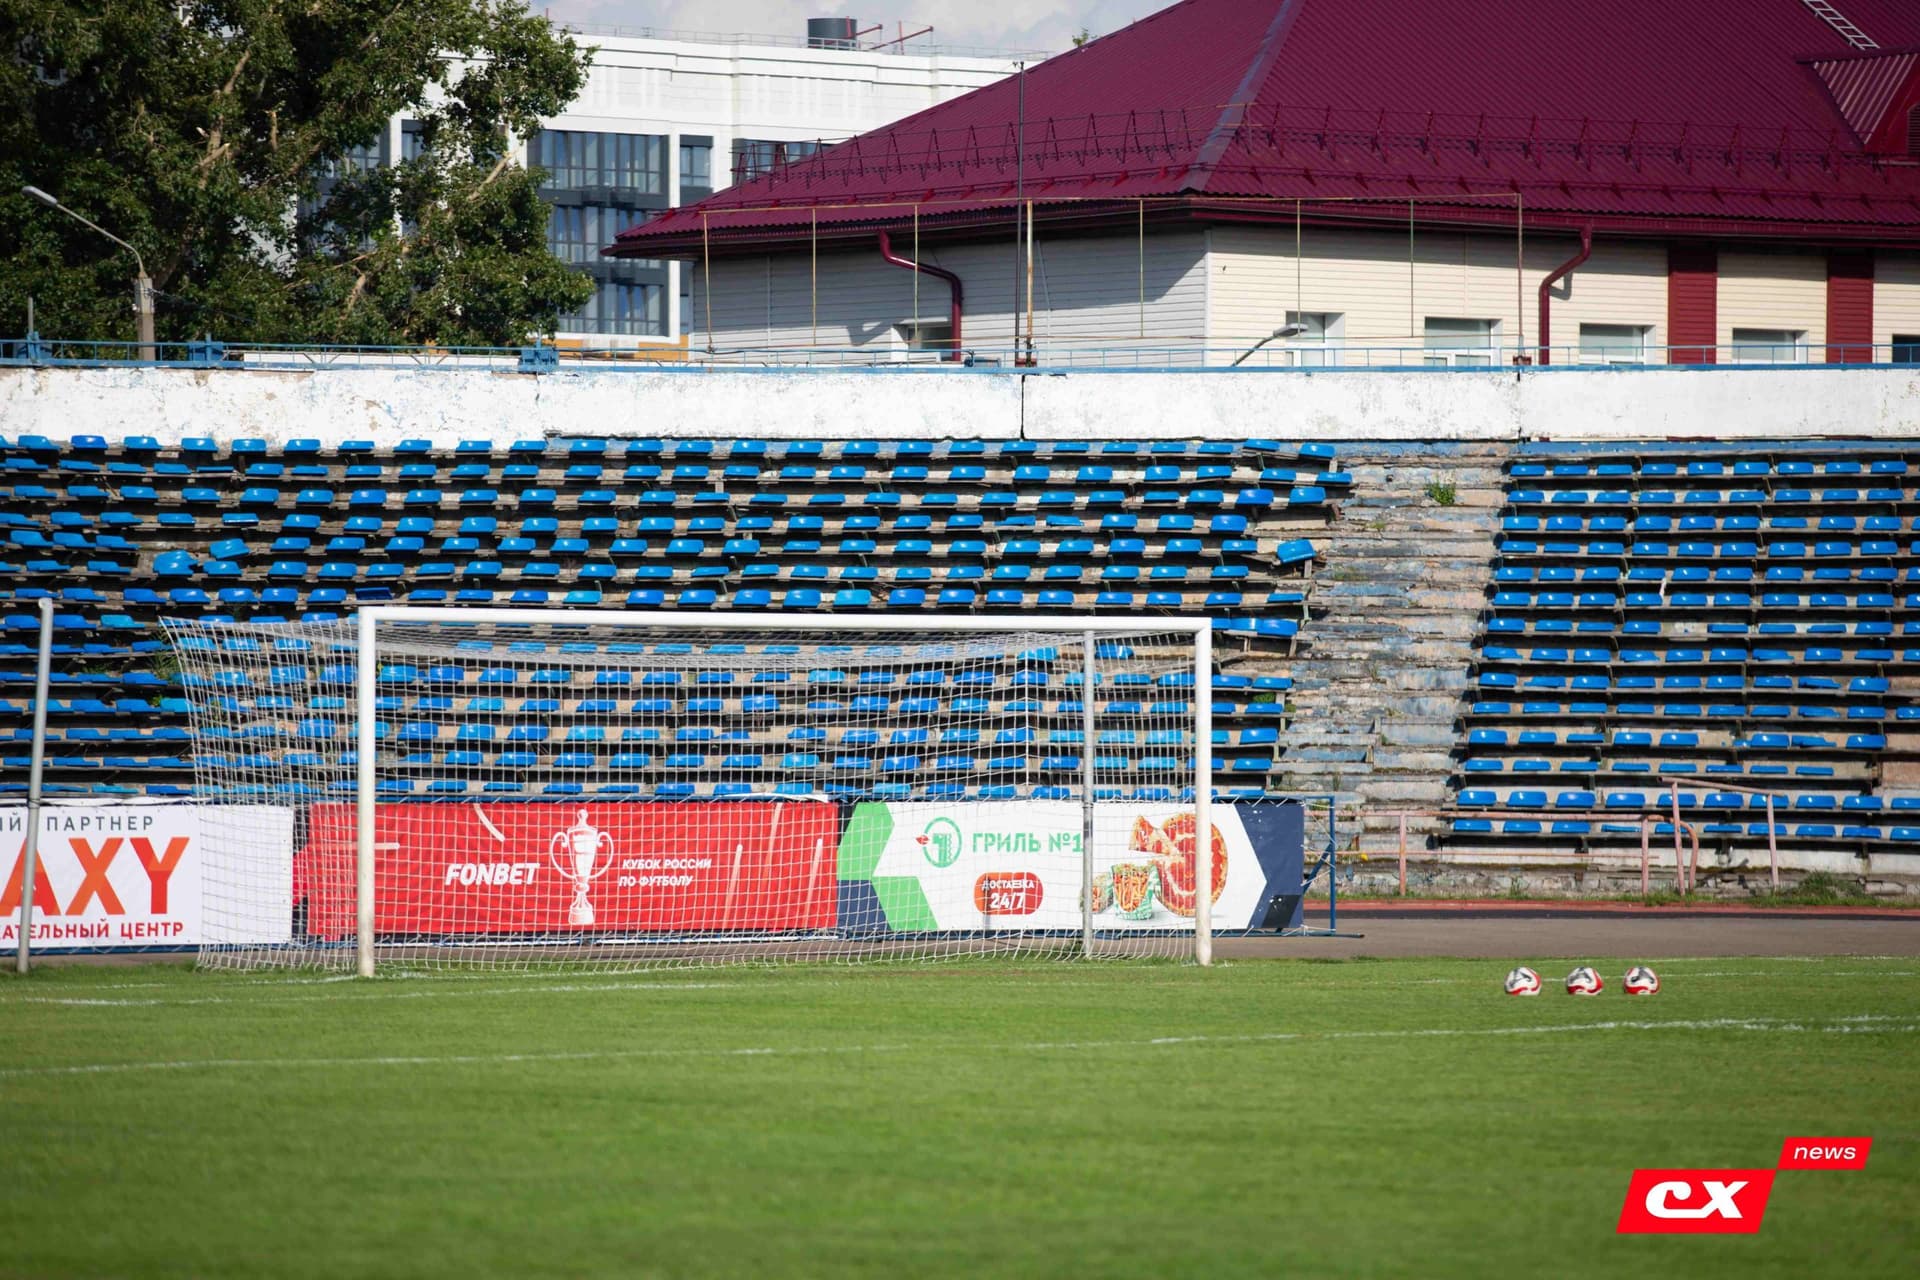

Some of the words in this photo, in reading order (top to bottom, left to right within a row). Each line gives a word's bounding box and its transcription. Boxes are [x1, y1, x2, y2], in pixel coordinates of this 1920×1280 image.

[0, 811, 21, 832] Й
[46, 815, 154, 832] ПАРТНЕР
[972, 832, 1042, 853] ГРИЛЬ
[1048, 832, 1084, 853] №1
[444, 862, 541, 886] FONBET
[622, 858, 661, 870] КУБОК
[662, 858, 712, 869] РОССИИ
[618, 875, 637, 887] ПО
[638, 874, 693, 887] ФУТБОЛУ
[989, 892, 1026, 910] 24/7
[0, 918, 110, 940] АТЕЛЬНЫЙ
[120, 921, 184, 940] ЦЕНТР
